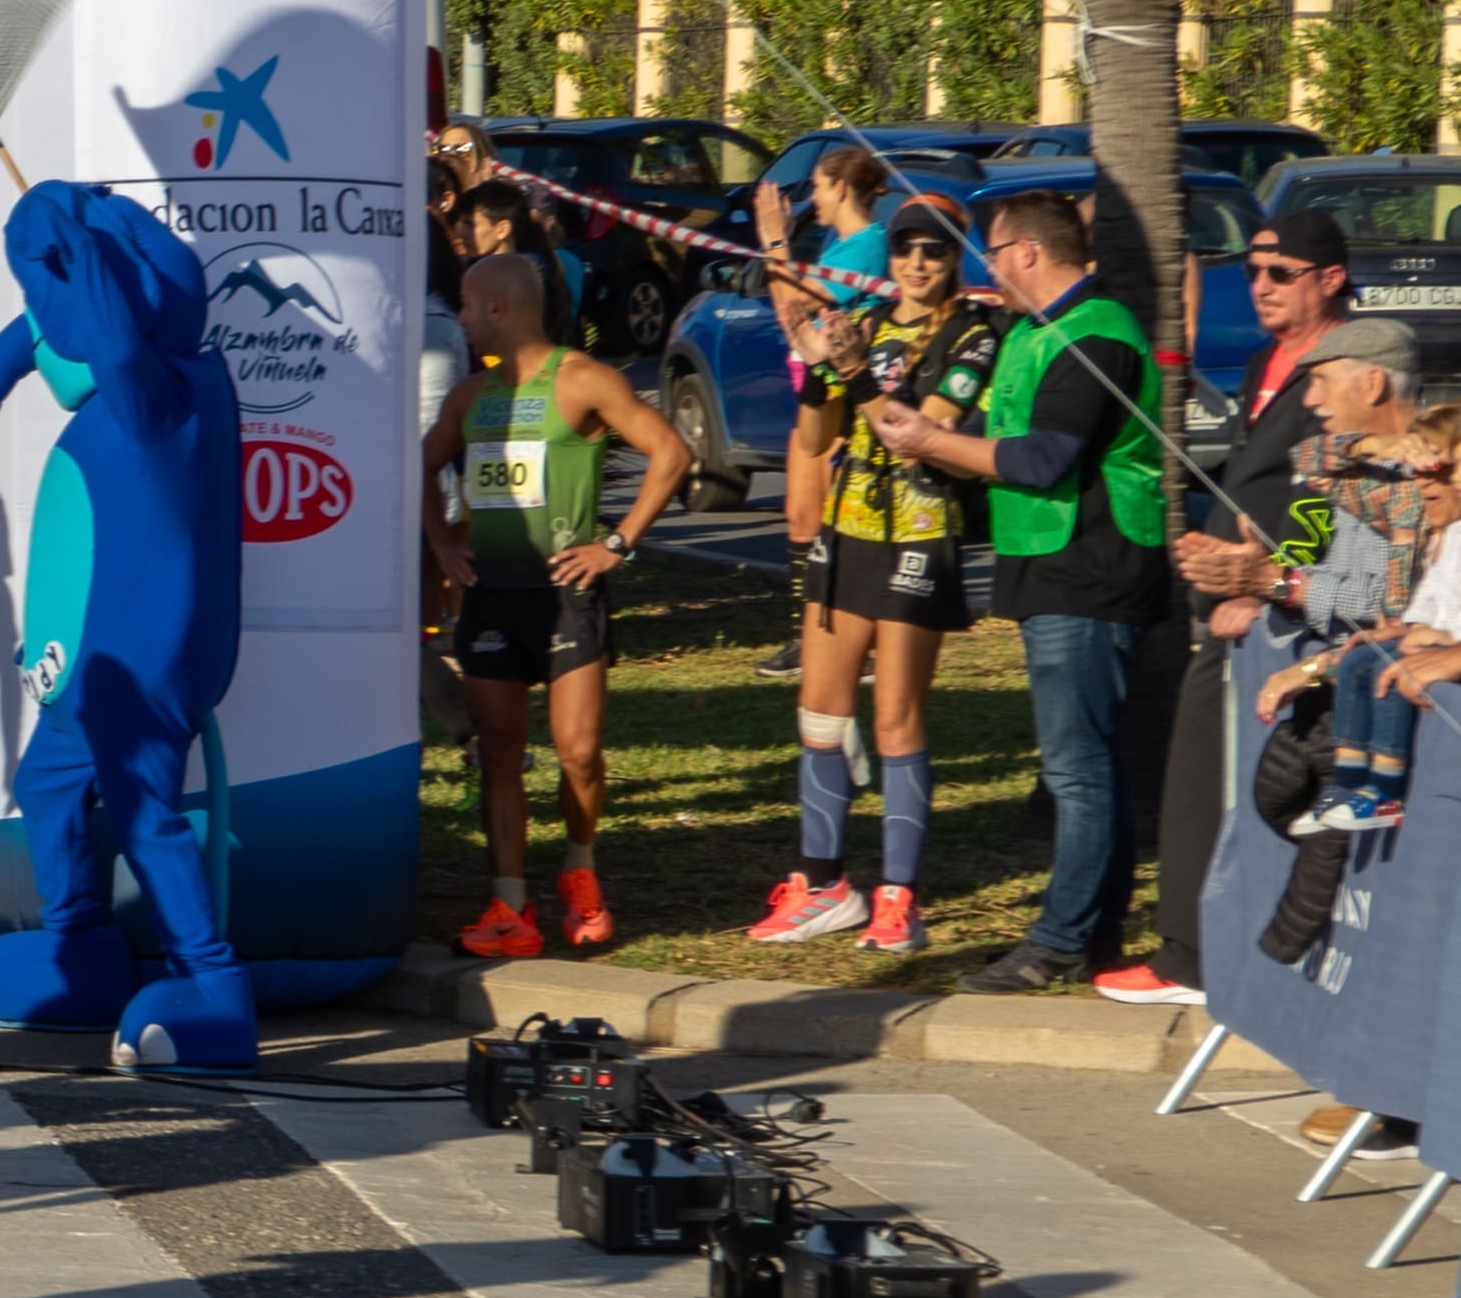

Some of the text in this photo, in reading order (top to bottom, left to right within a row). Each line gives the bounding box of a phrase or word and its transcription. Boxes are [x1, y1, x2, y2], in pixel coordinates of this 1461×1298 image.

[153, 186, 406, 239] dacion la Caixa
[333, 325, 360, 353] de
[237, 355, 327, 383] Viñuela
[269, 422, 281, 435] &
[284, 423, 337, 448] MANGO
[243, 446, 349, 524] OPS
[478, 462, 528, 487] 580
